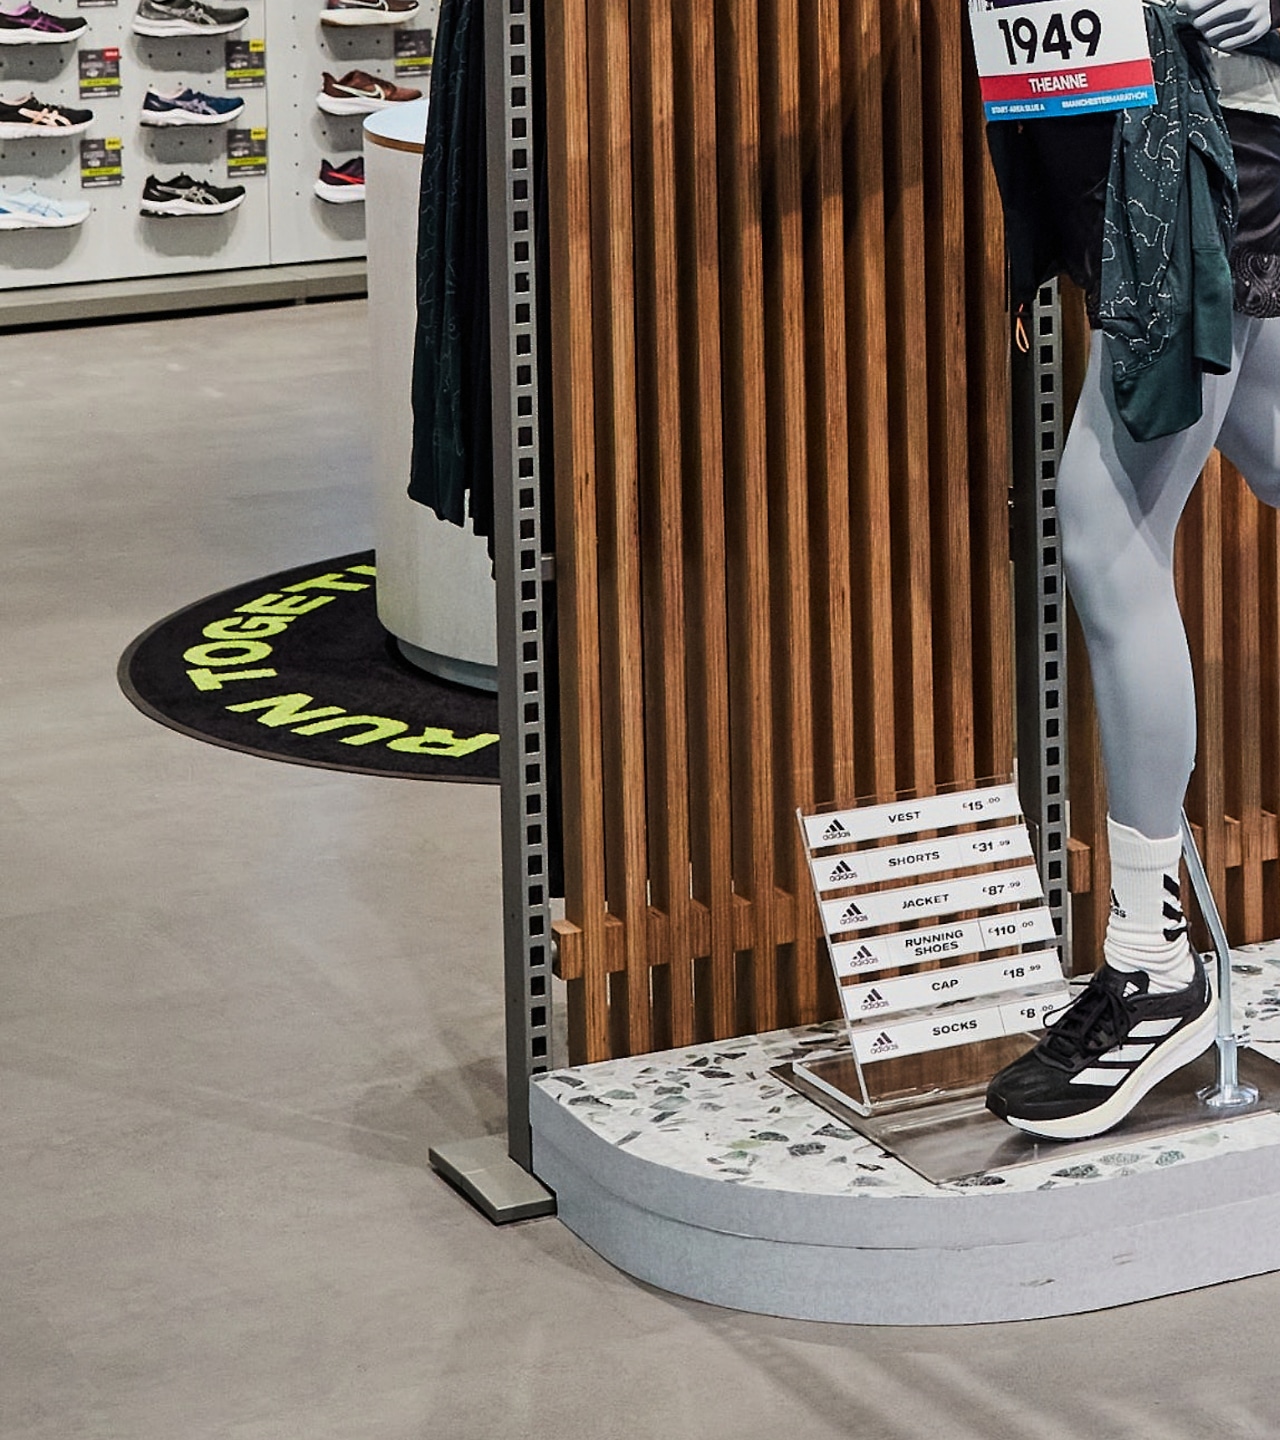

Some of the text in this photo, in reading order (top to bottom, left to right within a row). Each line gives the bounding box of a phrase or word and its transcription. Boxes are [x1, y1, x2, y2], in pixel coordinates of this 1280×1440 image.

[998, 8, 1103, 66] 1949
[1028, 73, 1089, 93] THEANNE
[183, 565, 500, 758] RUN TOGET
[888, 811, 921, 823] VEST
[962, 800, 983, 811] £15
[822, 830, 851, 841] adidas
[888, 851, 940, 867] SHORTS
[972, 841, 994, 853] £31
[829, 871, 858, 883] adidas
[902, 894, 949, 909] JACKET
[982, 884, 1005, 896] £87
[840, 914, 868, 925] adidas
[905, 929, 964, 948] RUNNING
[988, 924, 1016, 937] £110
[914, 941, 959, 956] SHOES
[850, 957, 879, 968] adidas
[931, 979, 959, 991] CAP
[1003, 968, 1025, 979] £18
[860, 1000, 889, 1012] adidas
[932, 1020, 978, 1036] SOCKS
[1020, 1008, 1036, 1019] £8
[870, 1043, 899, 1054] adidas
